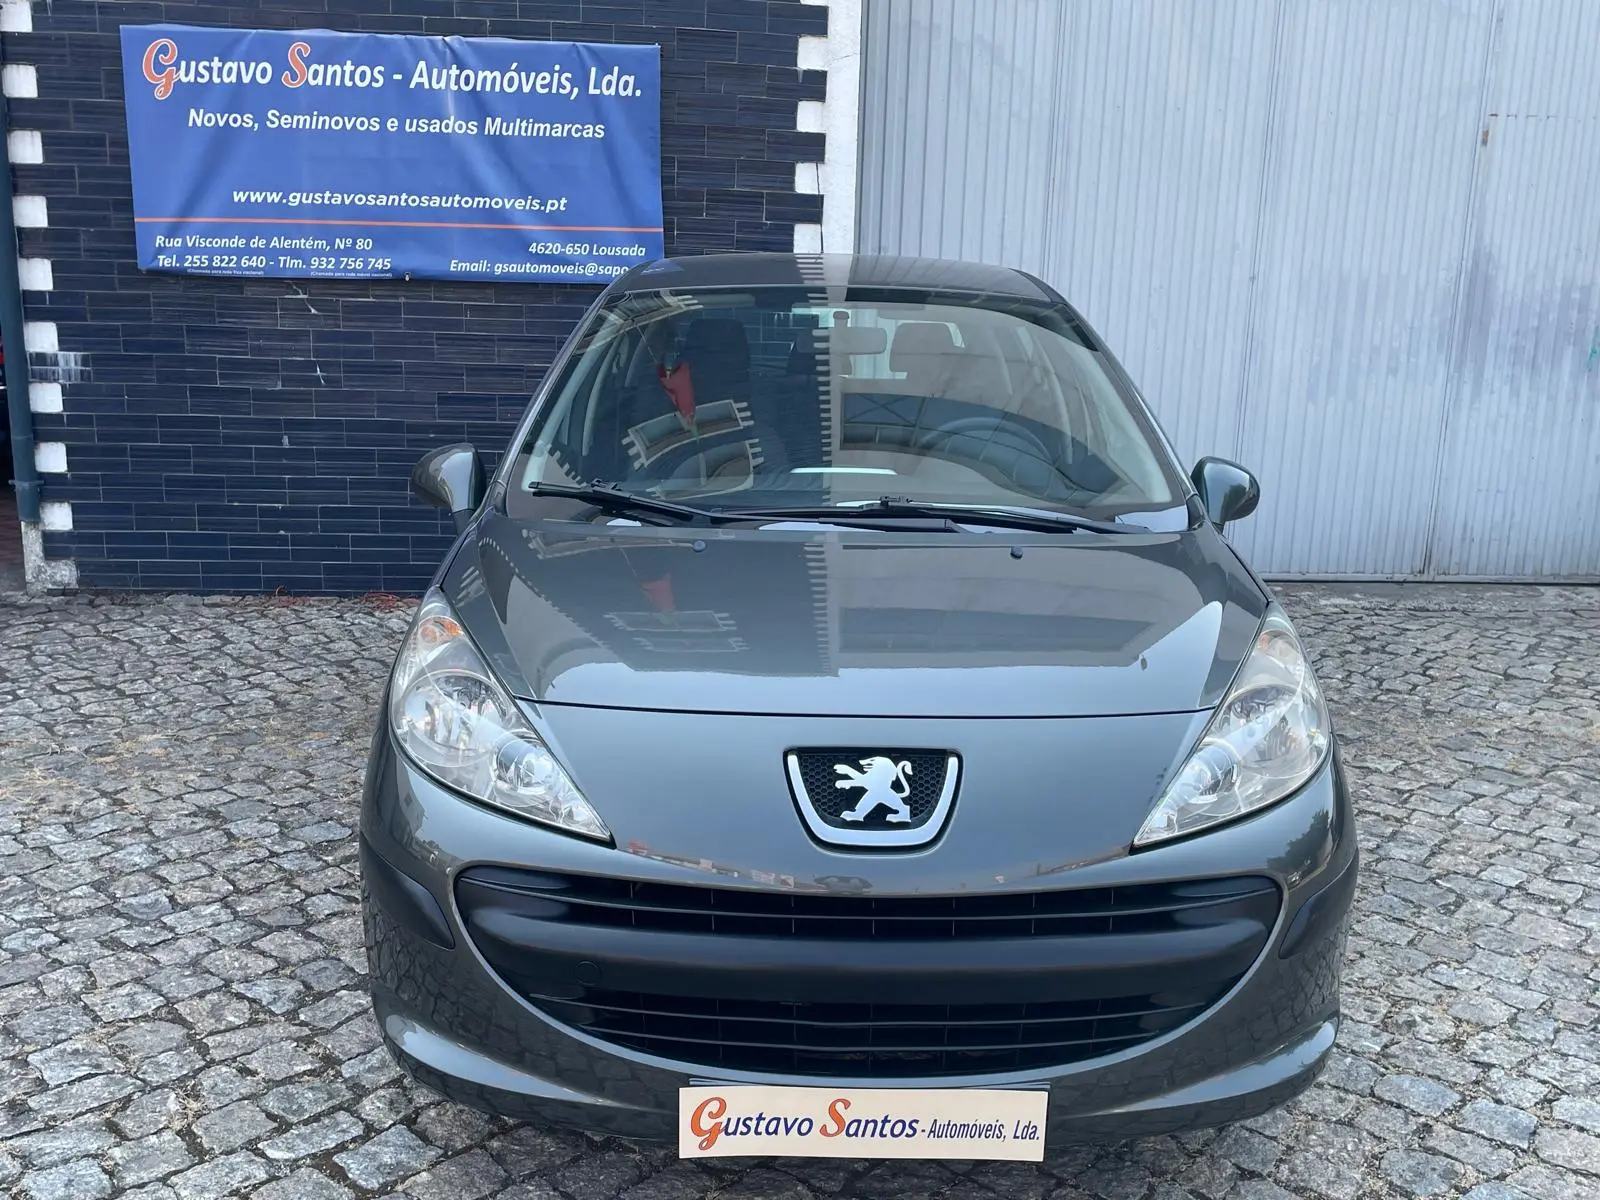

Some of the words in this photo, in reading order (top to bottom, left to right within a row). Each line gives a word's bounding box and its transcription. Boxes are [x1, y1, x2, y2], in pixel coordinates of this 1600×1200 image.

[143, 38, 273, 100] Gustavo
[281, 42, 385, 88] Santos
[409, 60, 579, 100] Automóveis,
[588, 65, 642, 97] Lda.
[188, 108, 259, 132] Novos,
[265, 109, 381, 131] Seminovos
[386, 118, 399, 131] e
[404, 115, 478, 135] usados
[484, 116, 606, 138] Multimarcas
[232, 189, 568, 213] www.gustavosantosautomoveis.pt
[155, 235, 182, 248] Rua
[185, 235, 246, 249] Visconde
[249, 236, 266, 249] de
[269, 236, 331, 251] Alentém,
[355, 238, 373, 250] 80
[528, 242, 590, 256] 4620-650
[592, 243, 646, 257] Lousada
[157, 254, 180, 268] Tel.
[183, 255, 209, 268] 255
[213, 255, 237, 268] 822
[241, 256, 266, 269] 640
[278, 256, 306, 269] Tlm.
[310, 256, 335, 269] 932
[339, 257, 364, 270] 756
[367, 257, 391, 270] 745
[450, 259, 491, 272] Email:
[690, 1096, 813, 1151] Gustavo
[819, 1098, 919, 1139] Santos
[927, 1118, 1007, 1143] Automóveis,
[1012, 1119, 1040, 1141] Lda.
